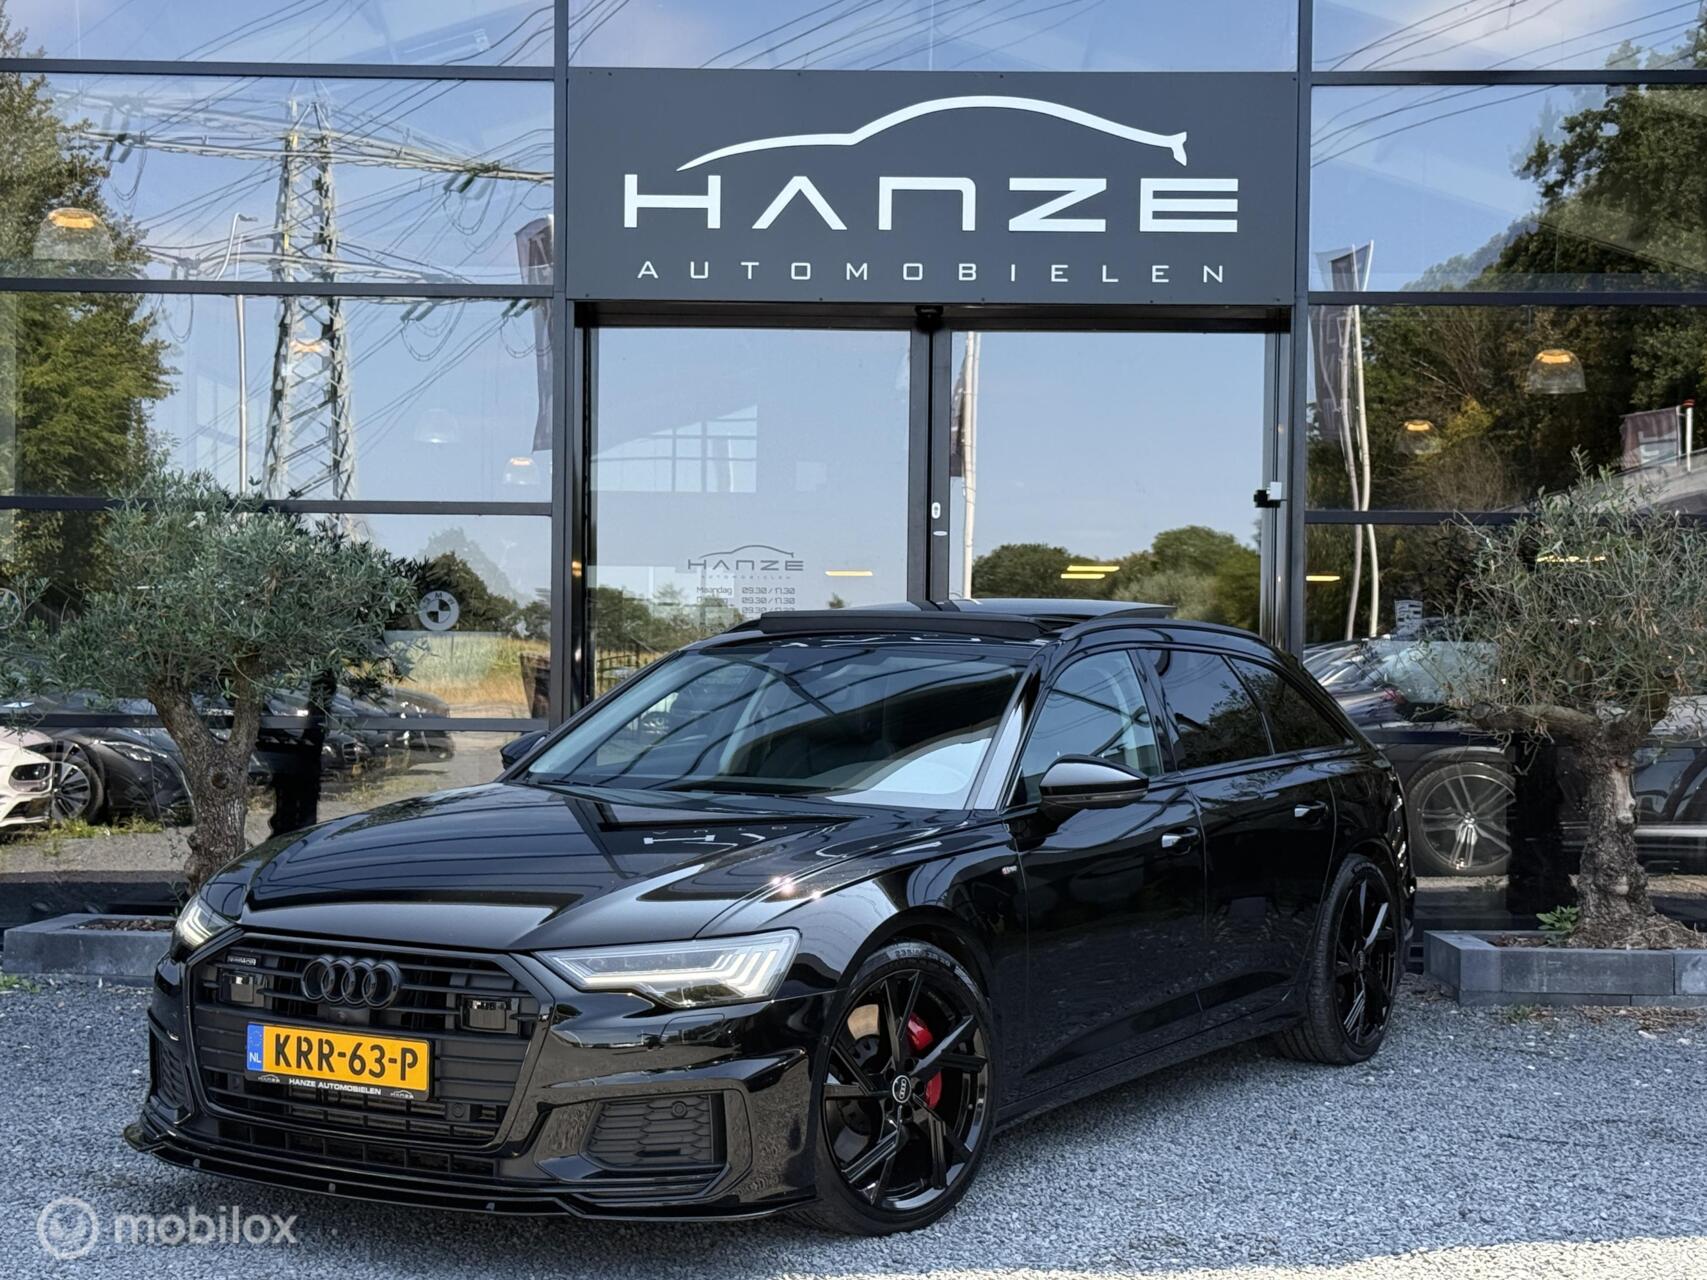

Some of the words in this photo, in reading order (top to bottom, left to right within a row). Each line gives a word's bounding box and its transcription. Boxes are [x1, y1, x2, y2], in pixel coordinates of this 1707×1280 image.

[624, 174, 1239, 233] HANZE
[637, 261, 1224, 284] AUTOMOBIELEN
[687, 559, 804, 571] HANZE
[696, 586, 733, 596] Maandag
[249, 1052, 262, 1064] NL
[274, 1033, 419, 1081] KRR-63-P
[289, 1078, 316, 1088] HANZE
[318, 1082, 382, 1096] AUTOMOBIELEN
